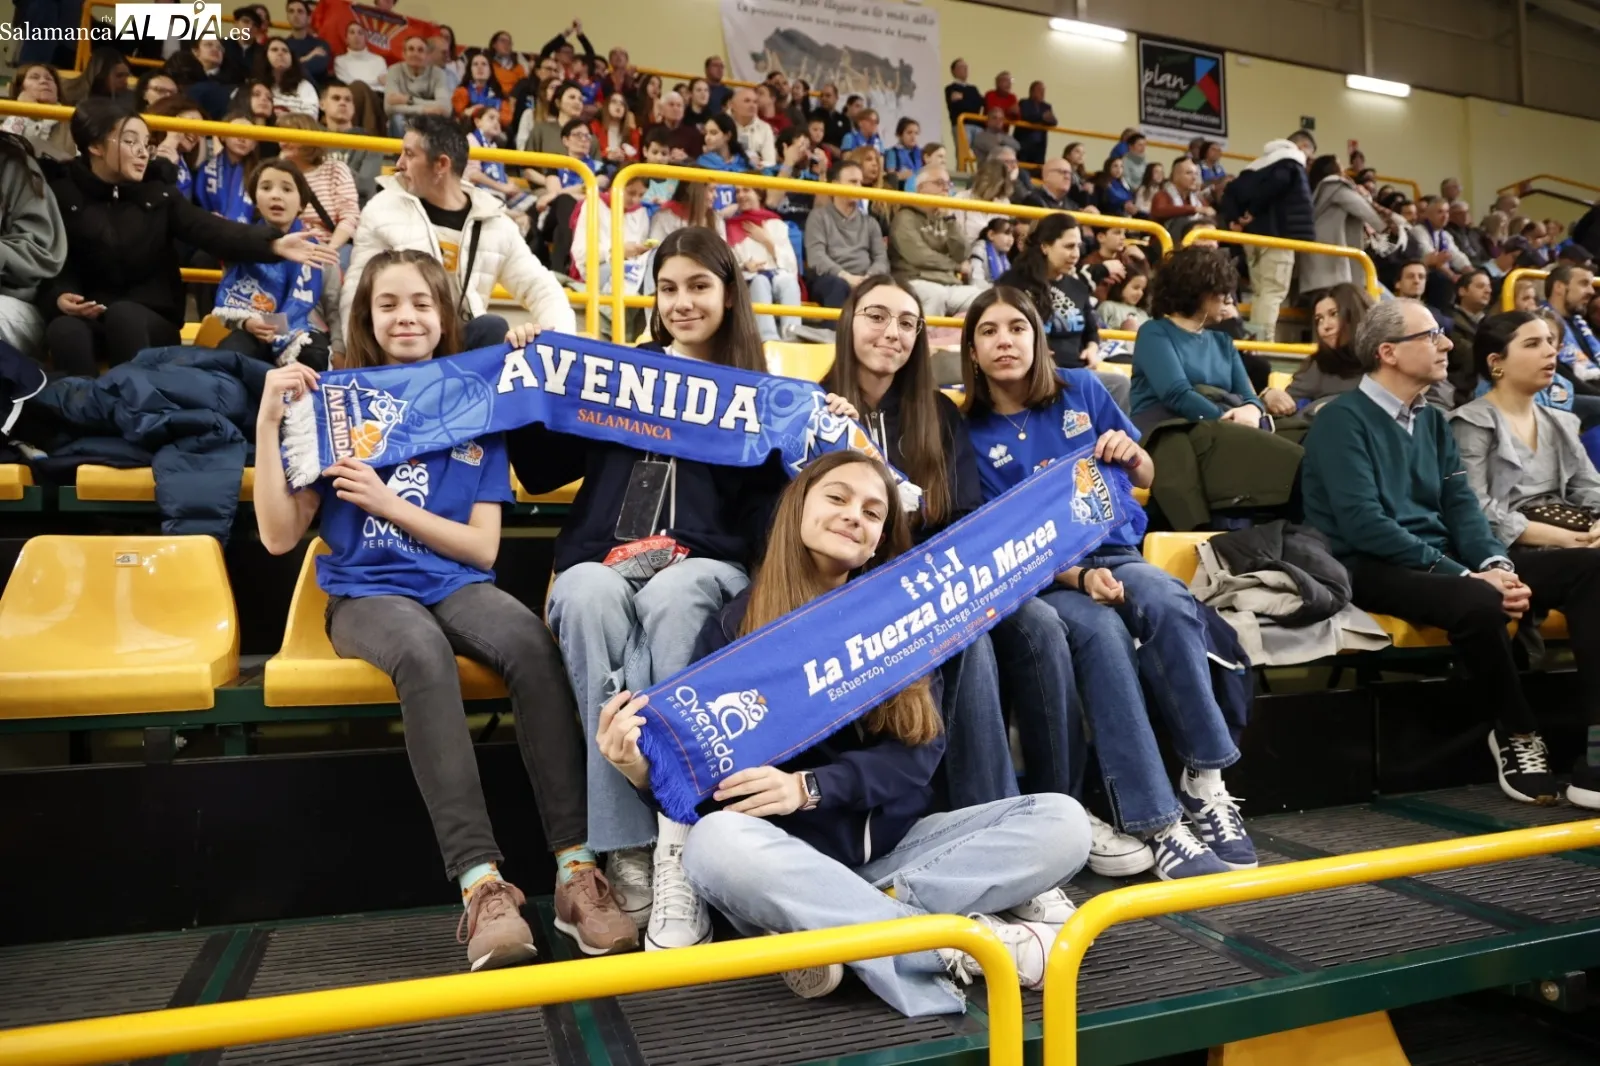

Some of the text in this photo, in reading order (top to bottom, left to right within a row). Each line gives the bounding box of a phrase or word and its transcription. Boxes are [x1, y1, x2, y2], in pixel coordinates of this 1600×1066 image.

[1142, 62, 1190, 92] plan
[327, 387, 354, 461] AVENIDA
[496, 343, 763, 434] AVENIDA
[577, 408, 673, 441] SALAMANCA
[803, 519, 1058, 696] La Fuerza de la Marea
[827, 665, 885, 702] Esfuerzo,
[883, 637, 927, 667] Corazón
[926, 631, 935, 644] y
[970, 581, 1008, 613] llevamos
[1008, 571, 1023, 589] por
[1022, 548, 1054, 575] bandera
